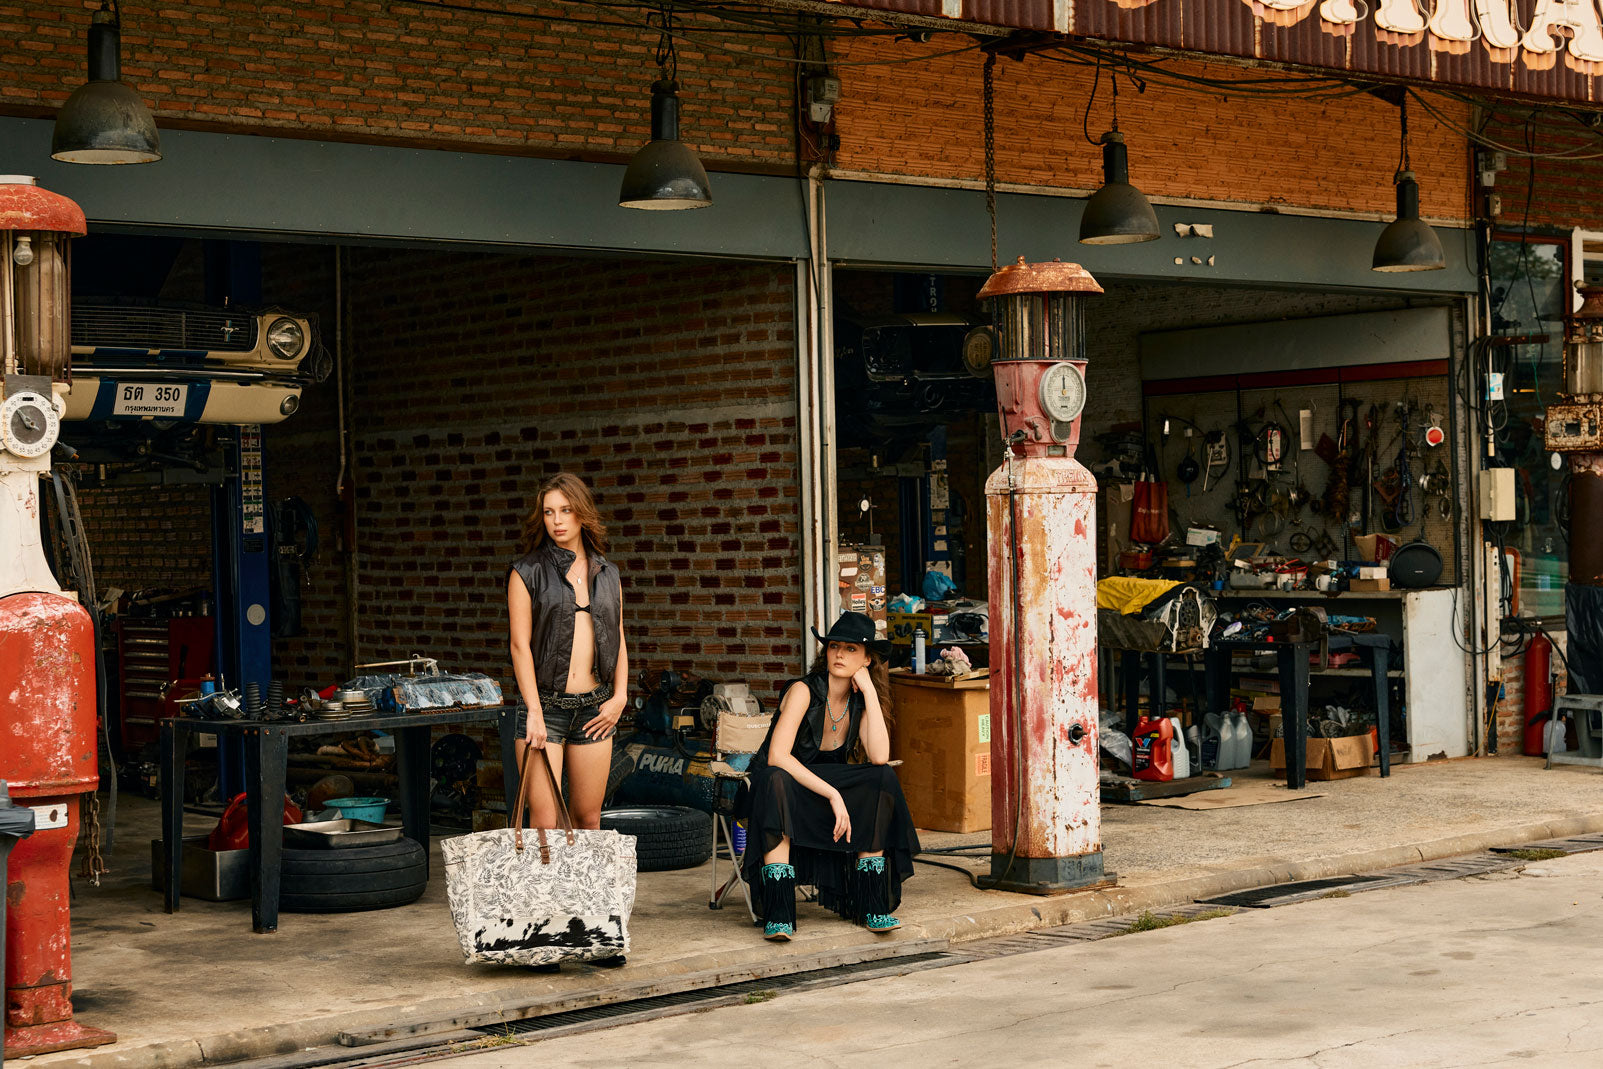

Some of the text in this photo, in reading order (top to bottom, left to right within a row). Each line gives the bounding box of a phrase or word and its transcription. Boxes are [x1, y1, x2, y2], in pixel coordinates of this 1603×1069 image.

[123, 386, 180, 402] ธต 350
[124, 405, 175, 414] กรุงเทพมหานคร
[639, 753, 685, 775] PUMA
